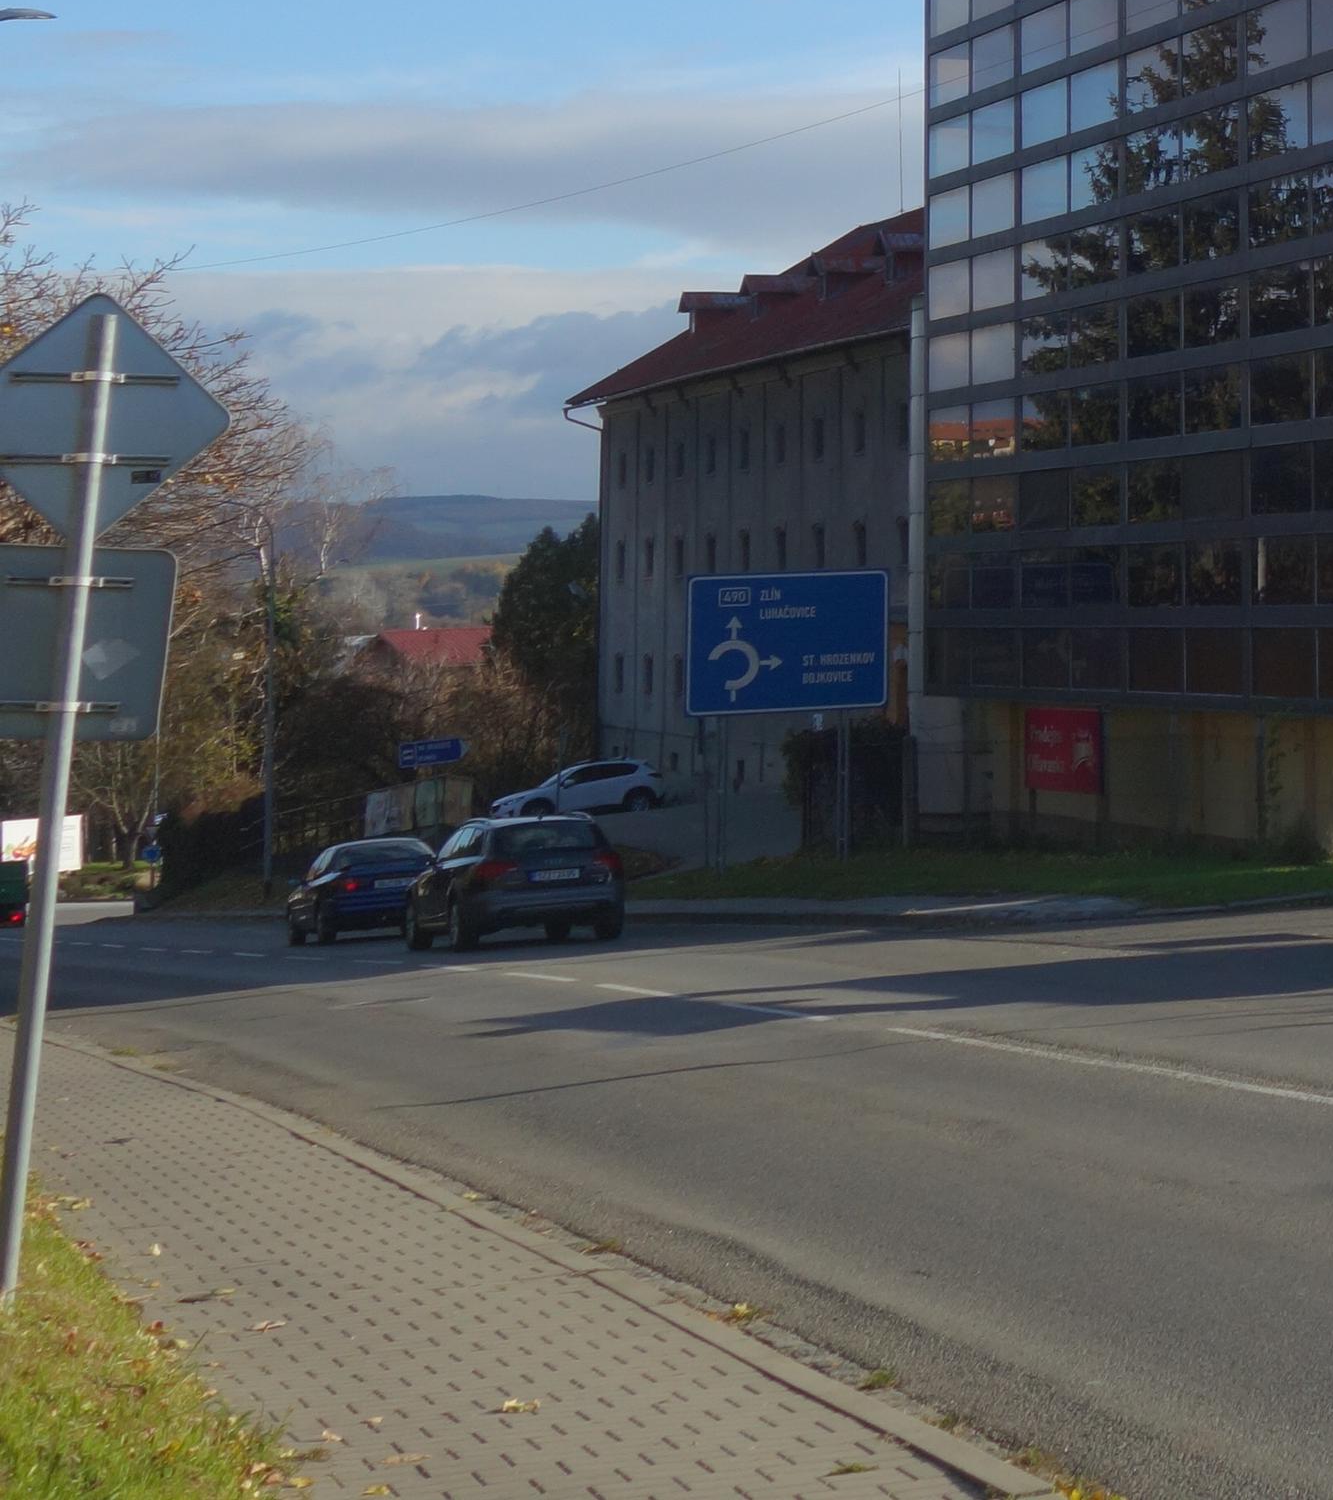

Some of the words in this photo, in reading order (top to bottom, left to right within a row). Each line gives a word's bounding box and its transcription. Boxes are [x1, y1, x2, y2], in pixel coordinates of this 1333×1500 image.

[721, 591, 746, 603] 490
[759, 586, 781, 601] ZLÍN
[759, 604, 817, 620] LUHAČOVICE
[820, 651, 876, 666] HROZENKOV
[802, 670, 854, 684] BOJKOVICE
